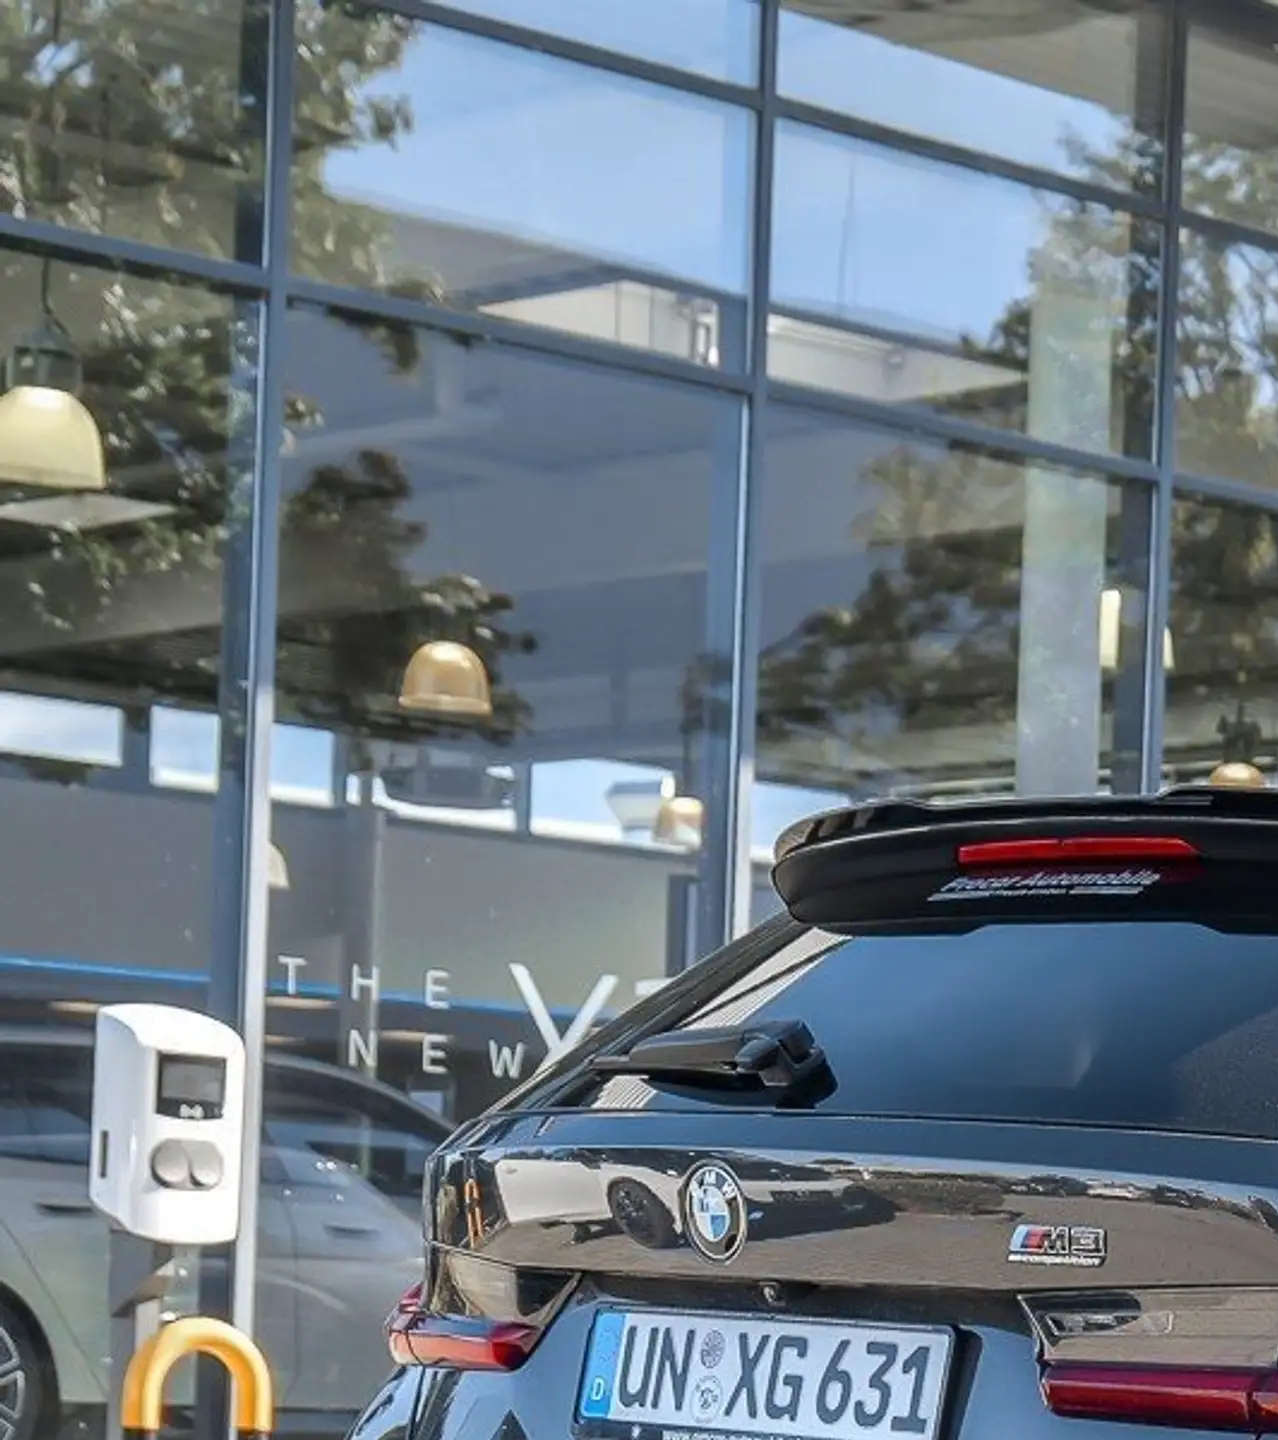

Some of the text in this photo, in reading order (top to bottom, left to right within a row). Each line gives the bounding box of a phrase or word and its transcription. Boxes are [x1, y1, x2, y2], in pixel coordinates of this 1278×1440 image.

[278, 956, 450, 1009] THE
[347, 1029, 526, 1079] NEW
[591, 1378, 604, 1401] D
[618, 1326, 932, 1433] UN XG 631
